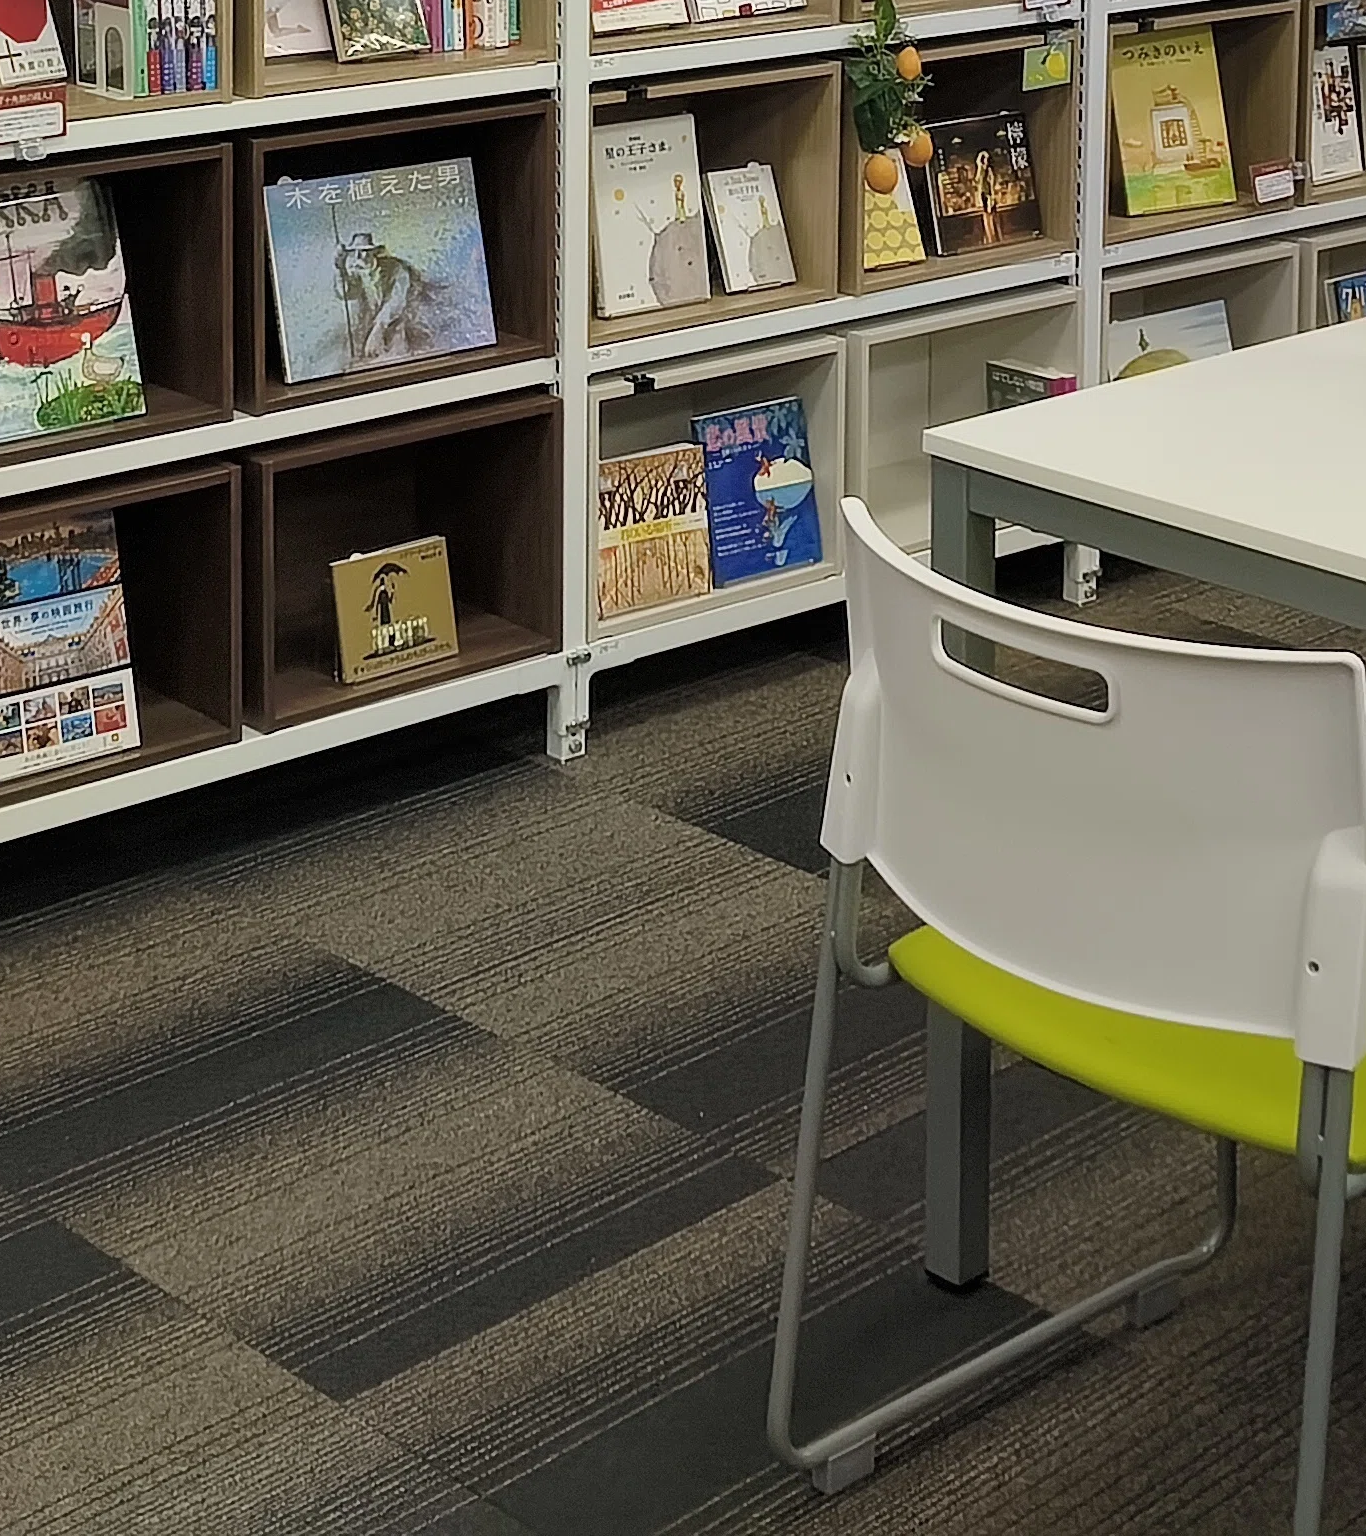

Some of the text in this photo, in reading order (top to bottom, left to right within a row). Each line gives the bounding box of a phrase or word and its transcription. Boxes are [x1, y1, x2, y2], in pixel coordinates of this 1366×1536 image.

[1121, 41, 1205, 63] つみきのいえ
[604, 141, 667, 160] 星の王子さま
[283, 164, 462, 210] 木を植えた男
